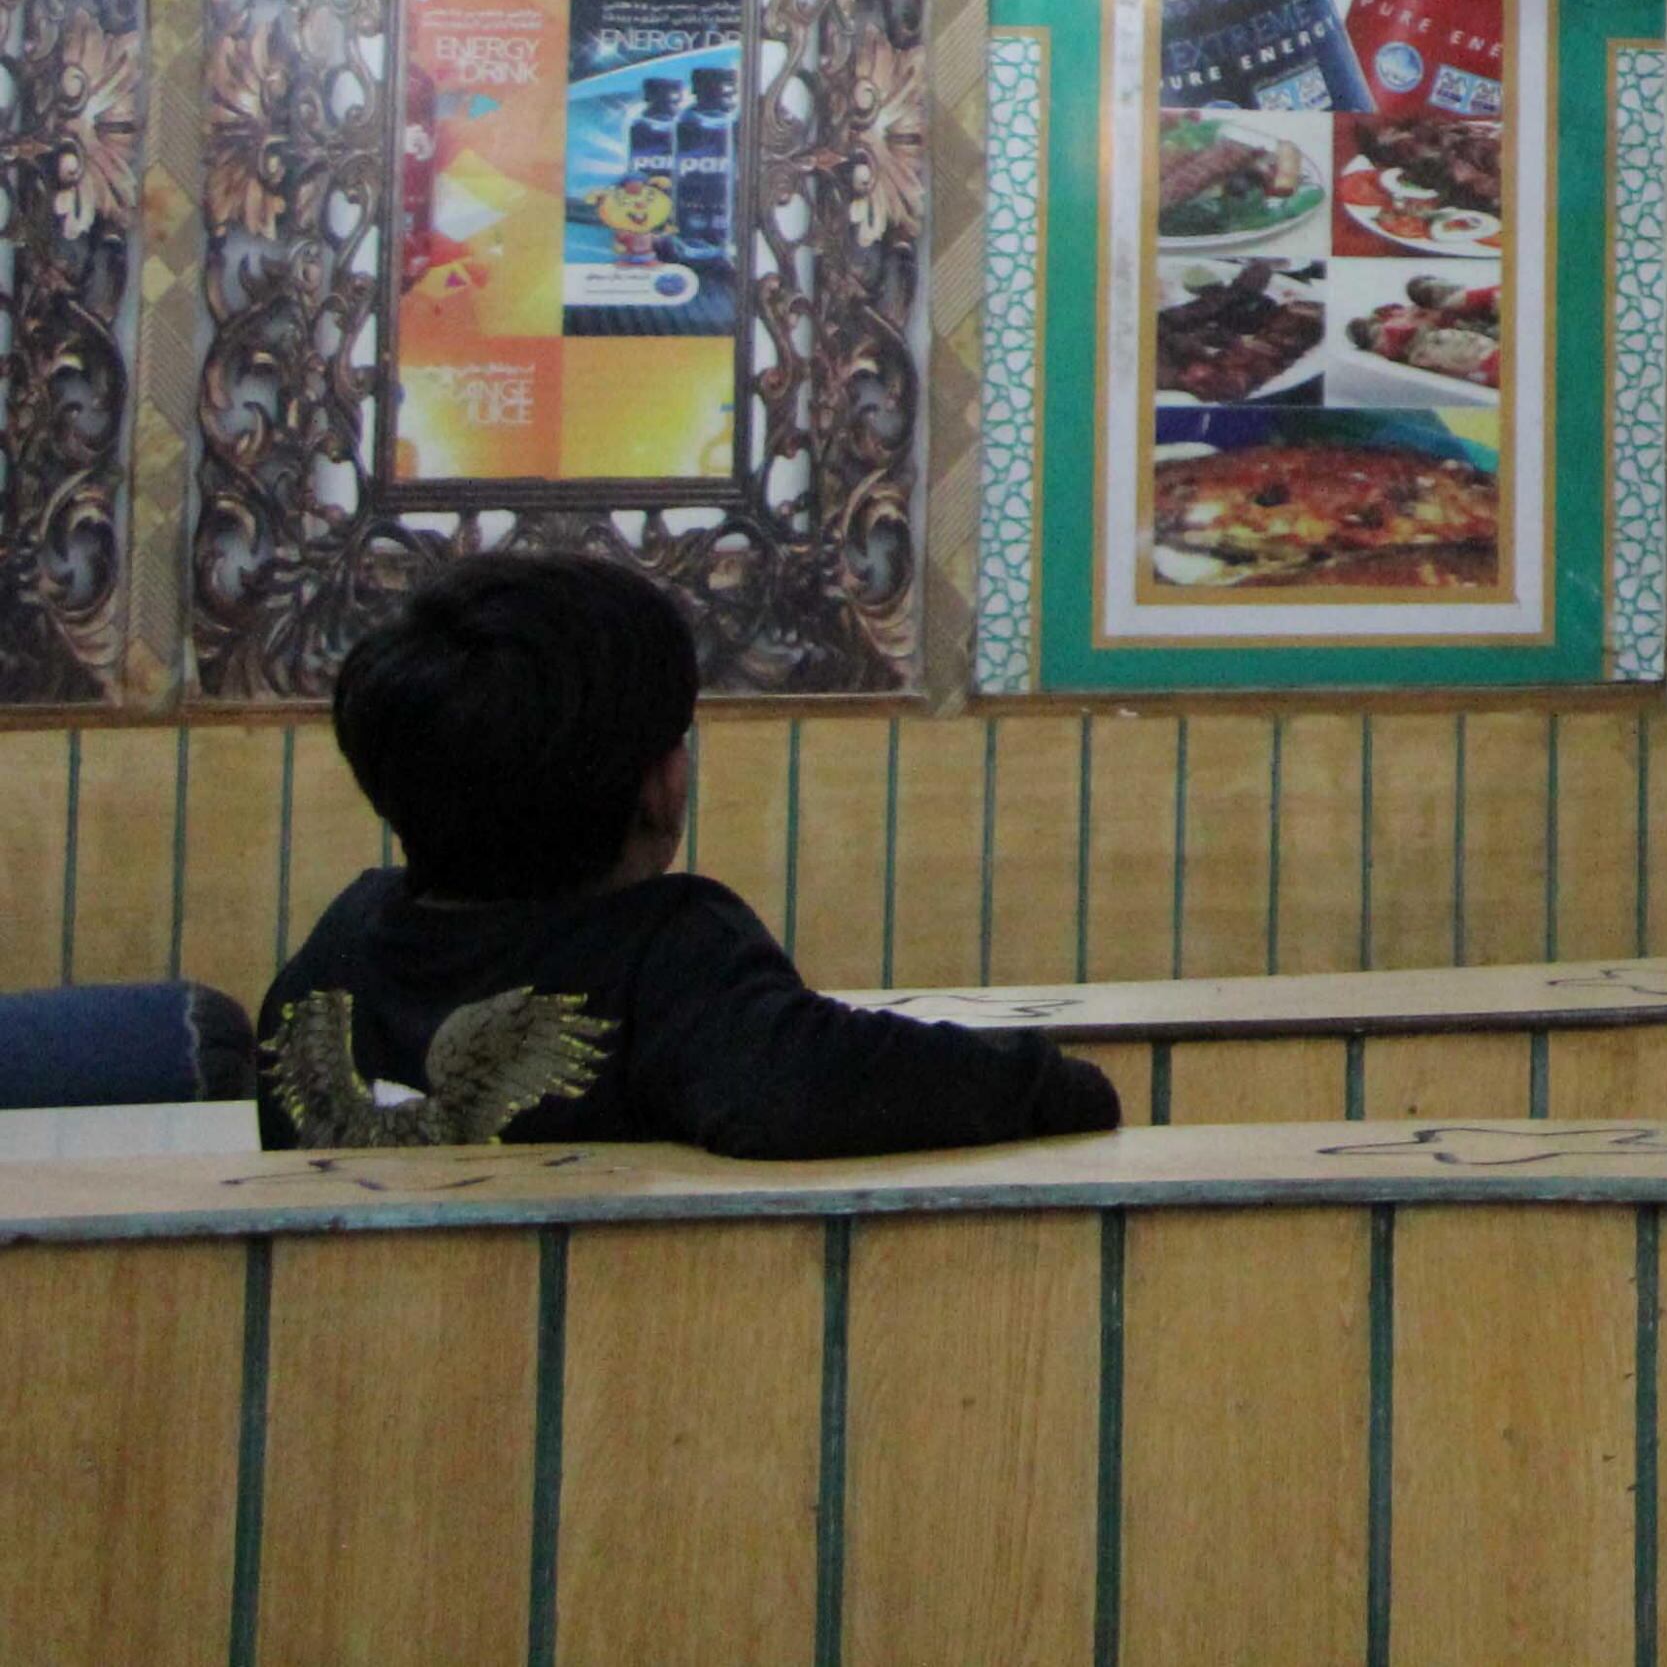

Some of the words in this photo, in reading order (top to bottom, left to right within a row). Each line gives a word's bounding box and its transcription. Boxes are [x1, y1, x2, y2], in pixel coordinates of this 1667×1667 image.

[436, 36, 540, 60] ENERGY
[599, 29, 700, 51] ENERGY
[1450, 29, 1503, 58] ENE
[459, 61, 541, 85] DRINK
